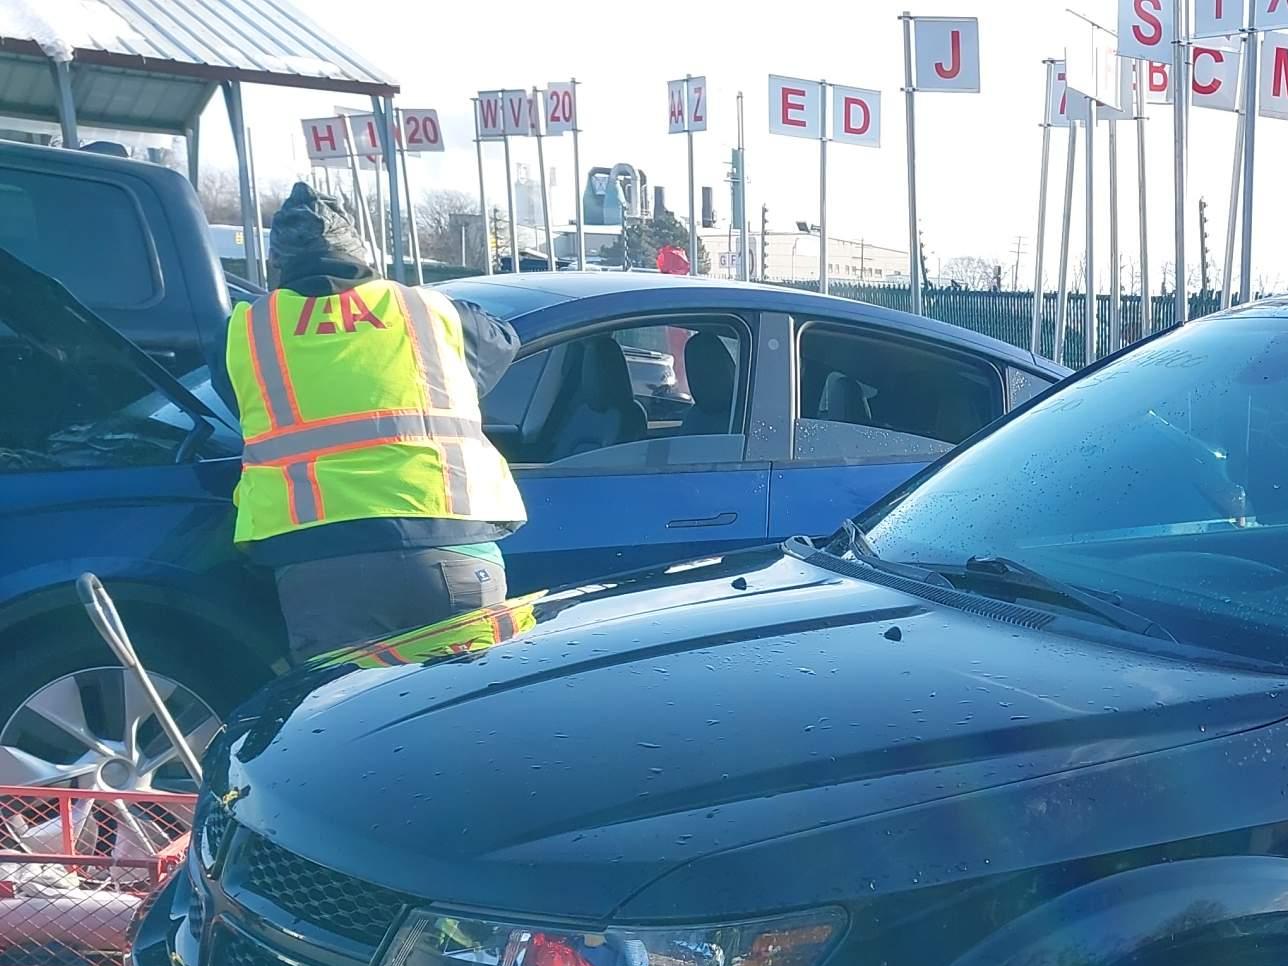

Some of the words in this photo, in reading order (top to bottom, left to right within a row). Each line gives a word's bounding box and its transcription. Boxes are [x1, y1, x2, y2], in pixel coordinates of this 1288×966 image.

[1132, 0, 1162, 46] S
[934, 30, 961, 79] J
[1192, 46, 1224, 95] C
[480, 98, 498, 128] W
[509, 98, 522, 128] V
[549, 90, 572, 122] 20
[669, 90, 685, 124] AA
[693, 87, 704, 122] Z
[781, 87, 807, 128] E
[843, 96, 871, 135] D
[311, 124, 337, 152] H
[406, 116, 439, 144] 20
